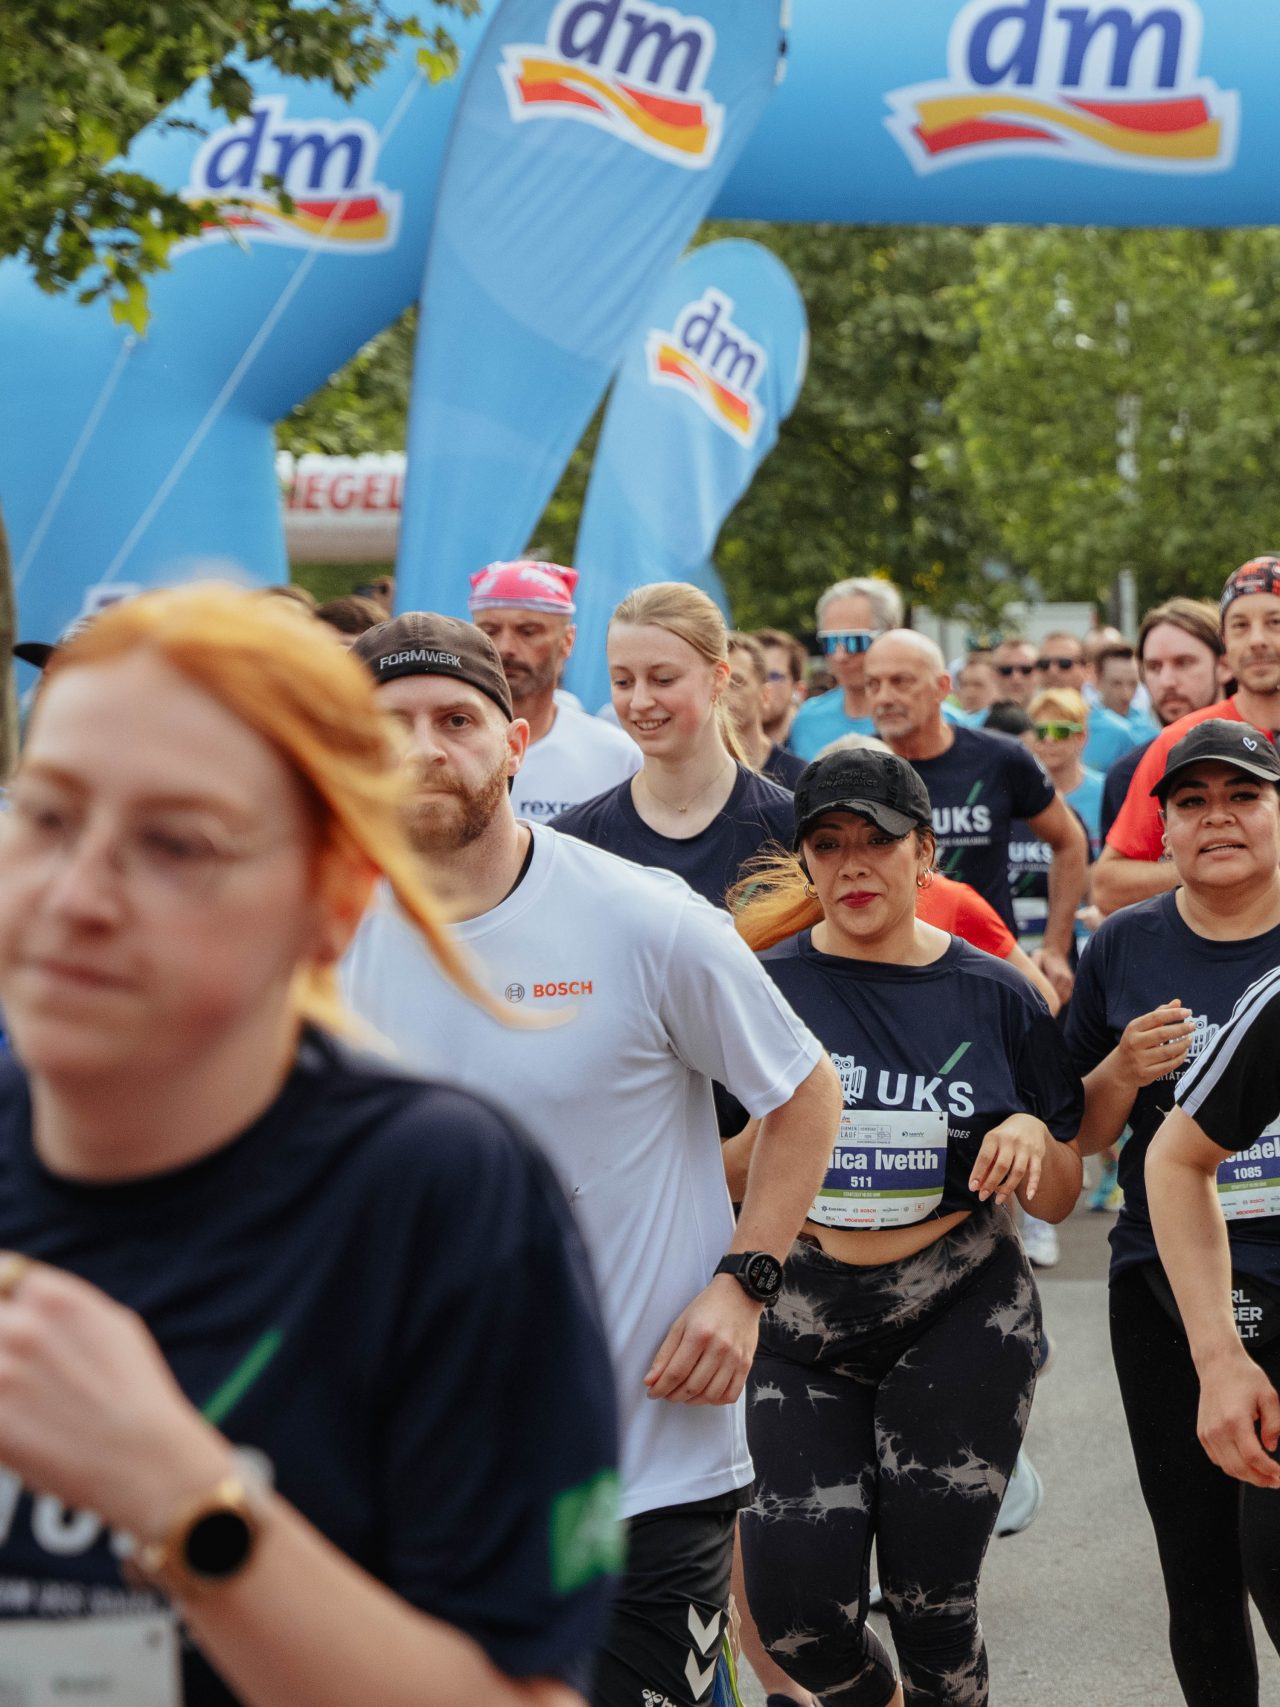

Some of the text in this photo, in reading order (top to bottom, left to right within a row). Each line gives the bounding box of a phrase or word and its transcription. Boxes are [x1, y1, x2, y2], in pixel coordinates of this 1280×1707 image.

[559, 0, 704, 93] dm
[967, 0, 1183, 89] dm
[206, 110, 364, 190] dm
[682, 301, 756, 389] dm
[379, 649, 462, 670] FORMWERK
[932, 804, 992, 835] UKS
[1007, 841, 1054, 865] UKS
[533, 980, 593, 998] BOSCH
[877, 1069, 976, 1118] UKS
[875, 1150, 939, 1170] Ivetth
[1233, 1166, 1263, 1180] 1085
[850, 1176, 872, 1188] 511
